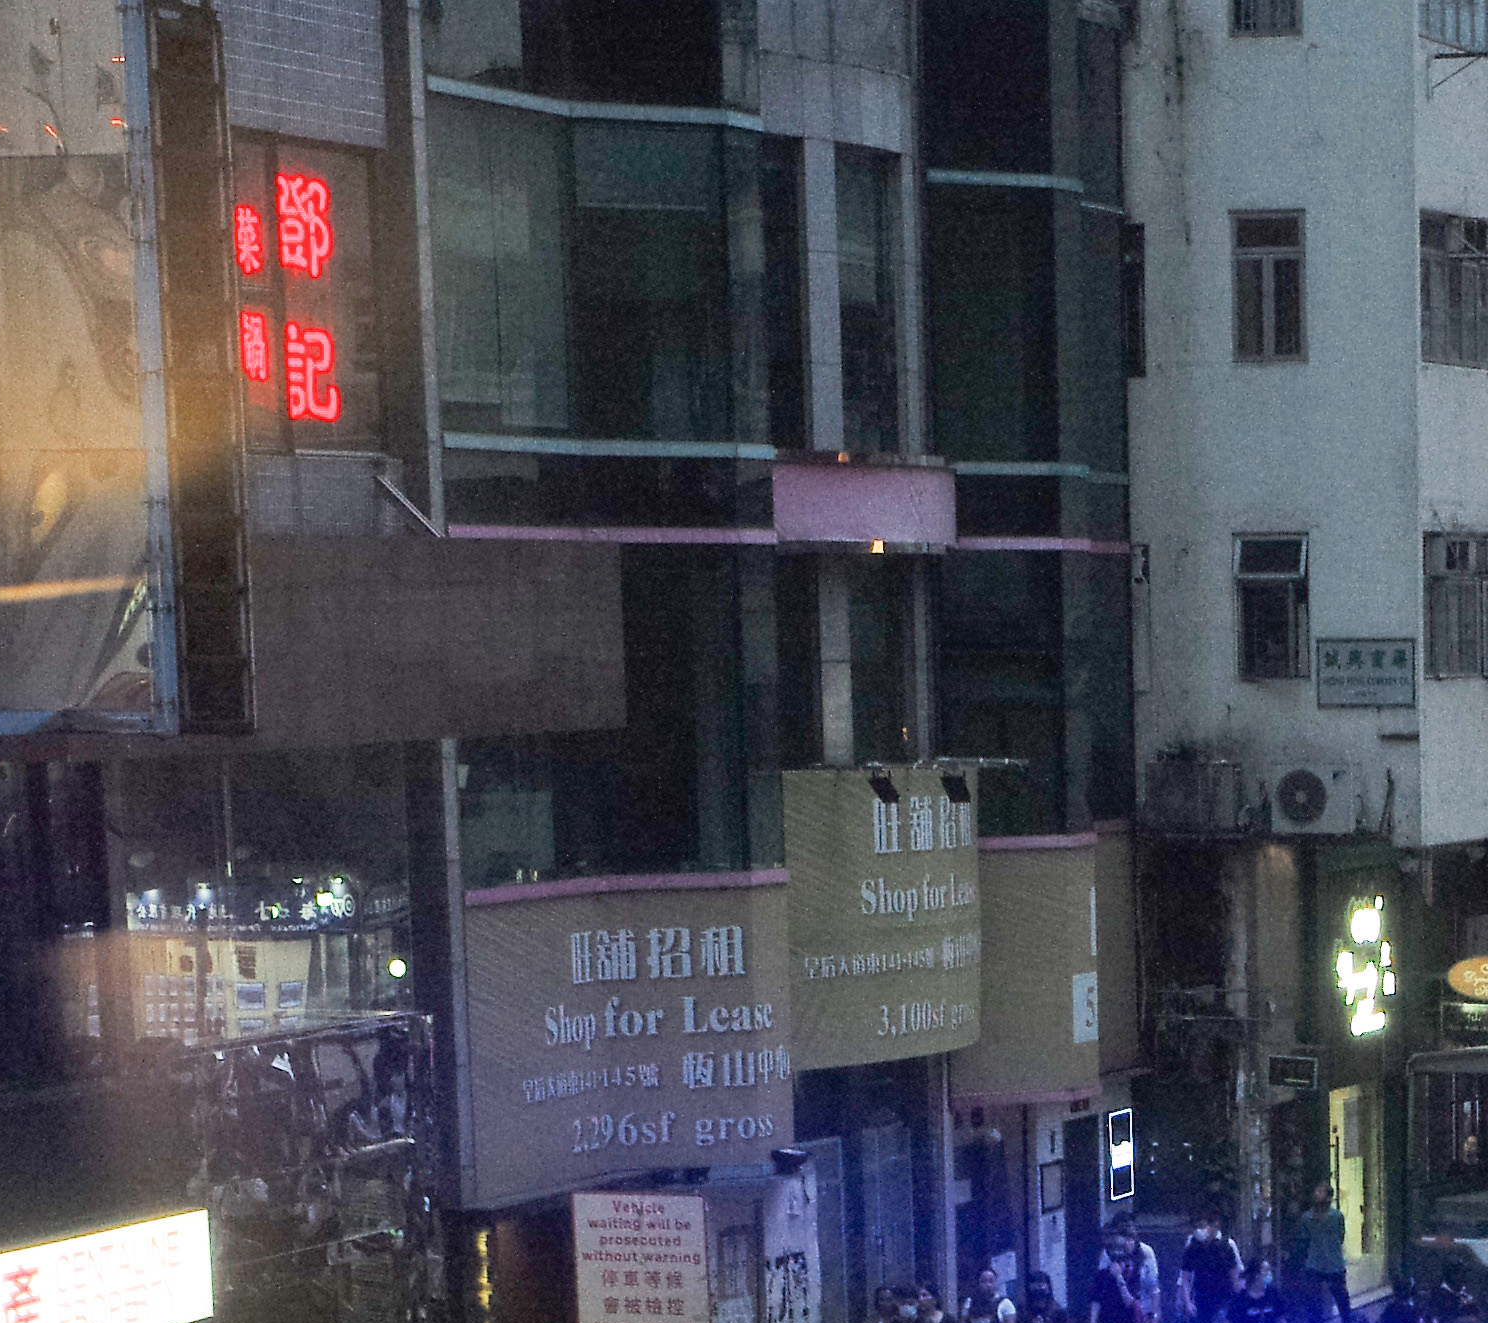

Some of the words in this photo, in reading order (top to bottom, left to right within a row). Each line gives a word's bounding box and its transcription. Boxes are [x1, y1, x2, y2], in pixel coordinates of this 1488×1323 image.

[275, 172, 341, 421] 鄧記
[861, 877, 919, 922] Shop
[923, 873, 946, 910] for
[570, 925, 746, 984] 旺舖招租
[545, 1004, 596, 1050] Shop
[605, 996, 664, 1038] for
[681, 996, 774, 1034] Lease
[695, 1113, 774, 1146] gross
[587, 1218, 641, 1231] waiting
[647, 1218, 671, 1230] will
[675, 1219, 692, 1230] be
[613, 1200, 665, 1214] Vehicle
[55, 1229, 182, 1293] CENTALINE
[582, 1251, 638, 1262] without
[642, 1252, 701, 1265] warning
[599, 1235, 681, 1247] prosecuted
